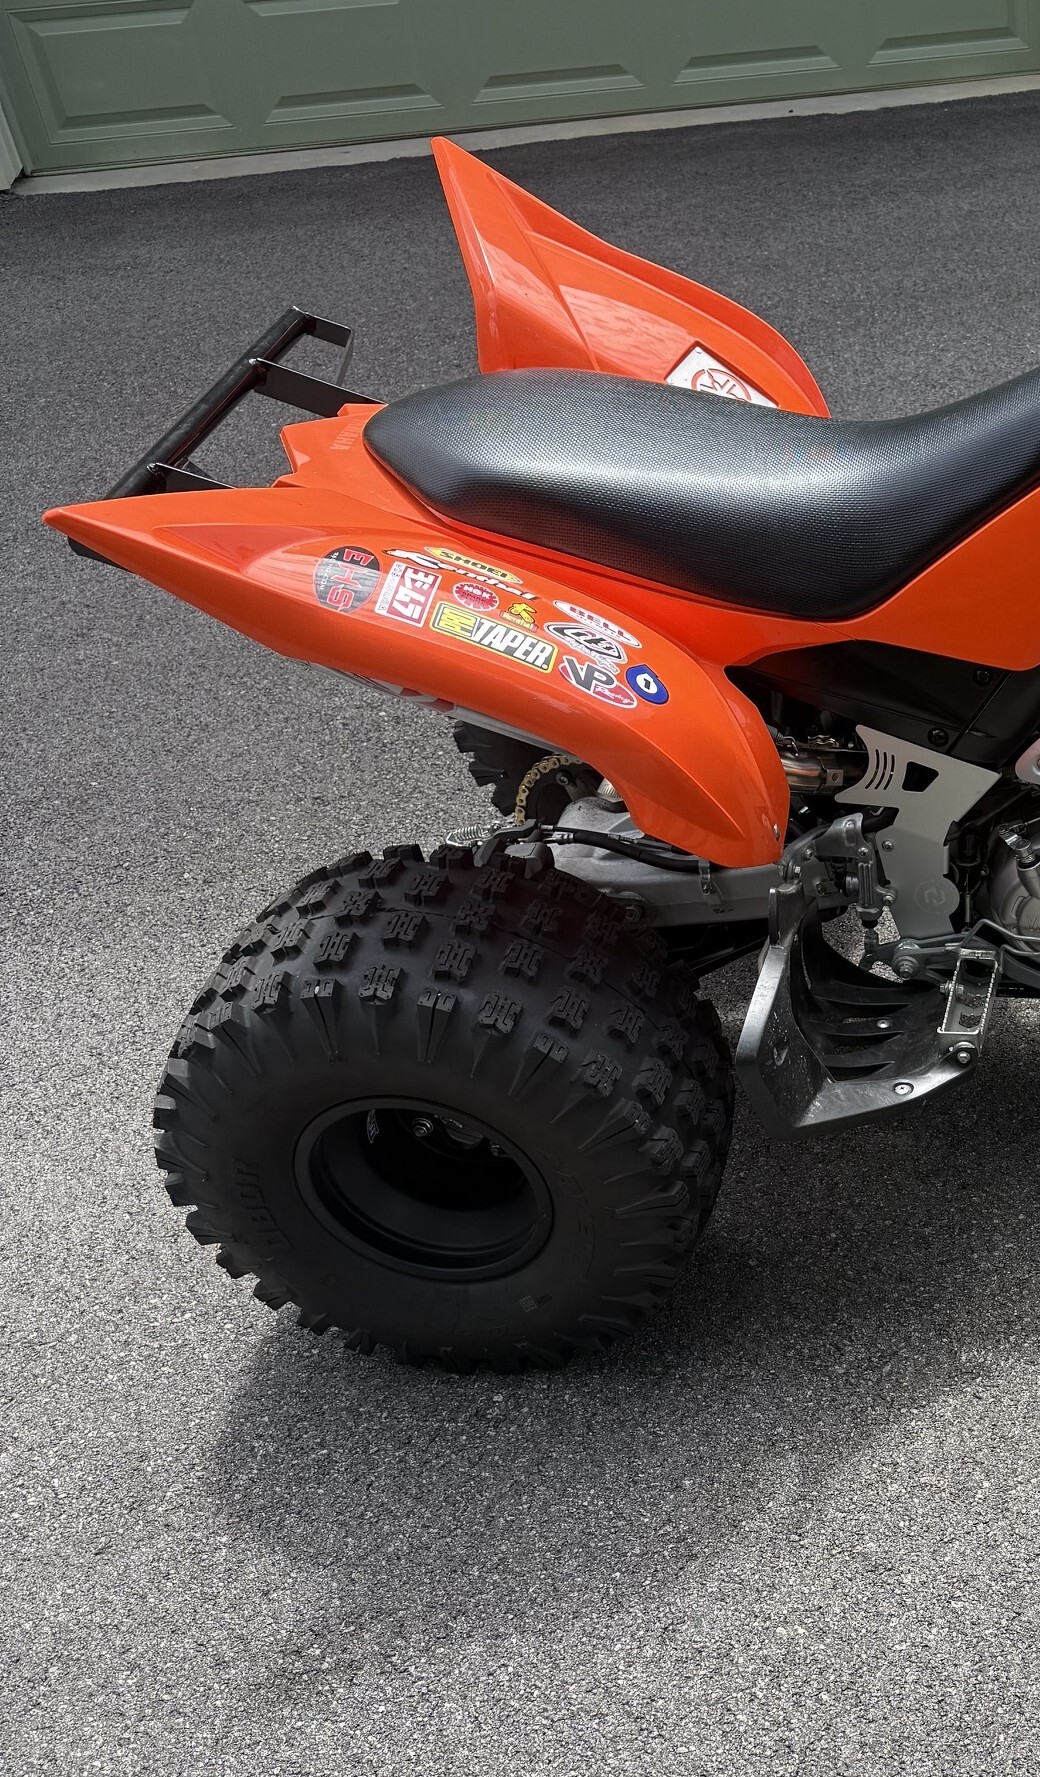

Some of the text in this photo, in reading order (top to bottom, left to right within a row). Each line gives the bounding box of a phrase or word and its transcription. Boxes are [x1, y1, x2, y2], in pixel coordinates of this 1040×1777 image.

[327, 548, 375, 612] EHS
[440, 550, 508, 578] SHOEI
[564, 657, 616, 692] VP
